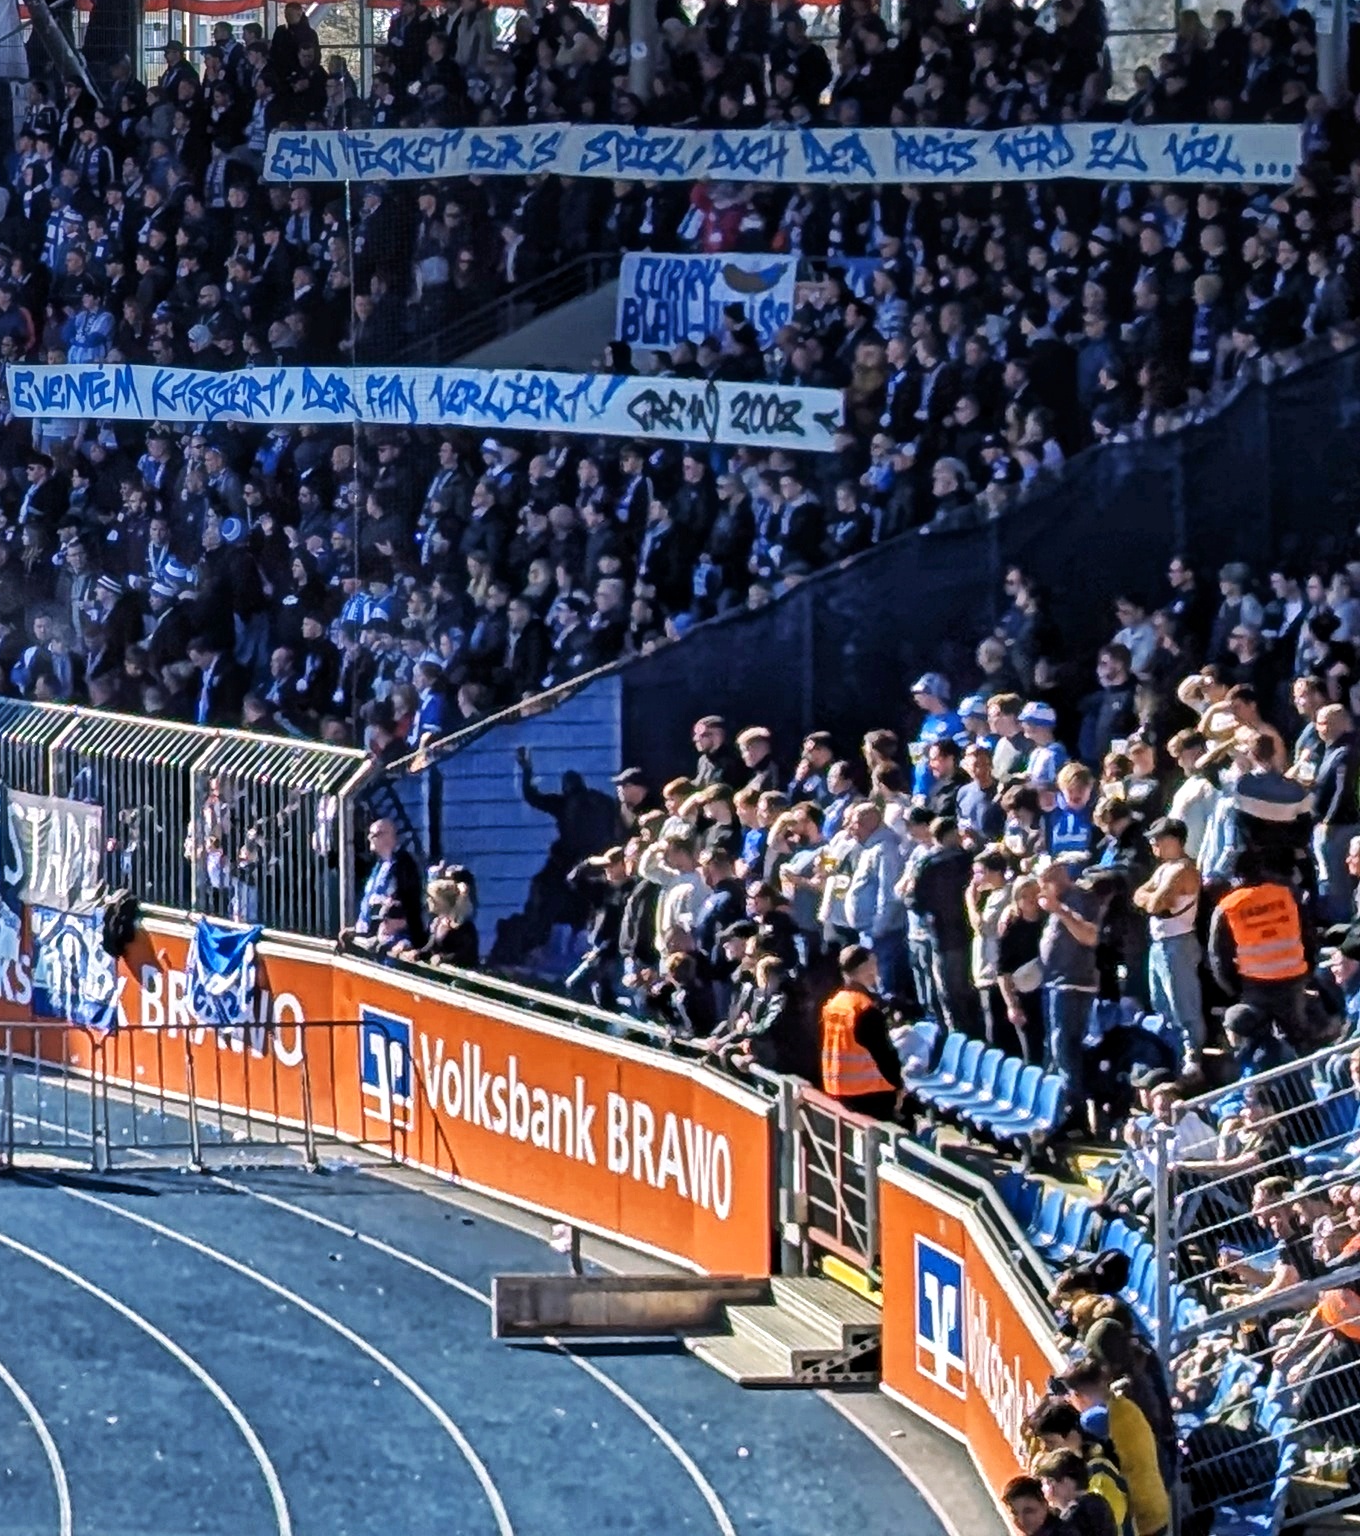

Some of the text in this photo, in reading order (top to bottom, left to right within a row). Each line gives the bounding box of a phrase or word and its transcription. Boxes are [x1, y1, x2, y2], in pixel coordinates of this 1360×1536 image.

[270, 137, 339, 179] EIN
[344, 128, 465, 175] TICKET
[800, 130, 878, 178] DER
[893, 128, 978, 177] PREIS
[989, 124, 1074, 173] WIRD
[1086, 130, 1149, 173] ZU
[301, 365, 361, 418] DER
[365, 372, 418, 425] FAN
[419, 1031, 733, 1222] Volksbank BRAWO
